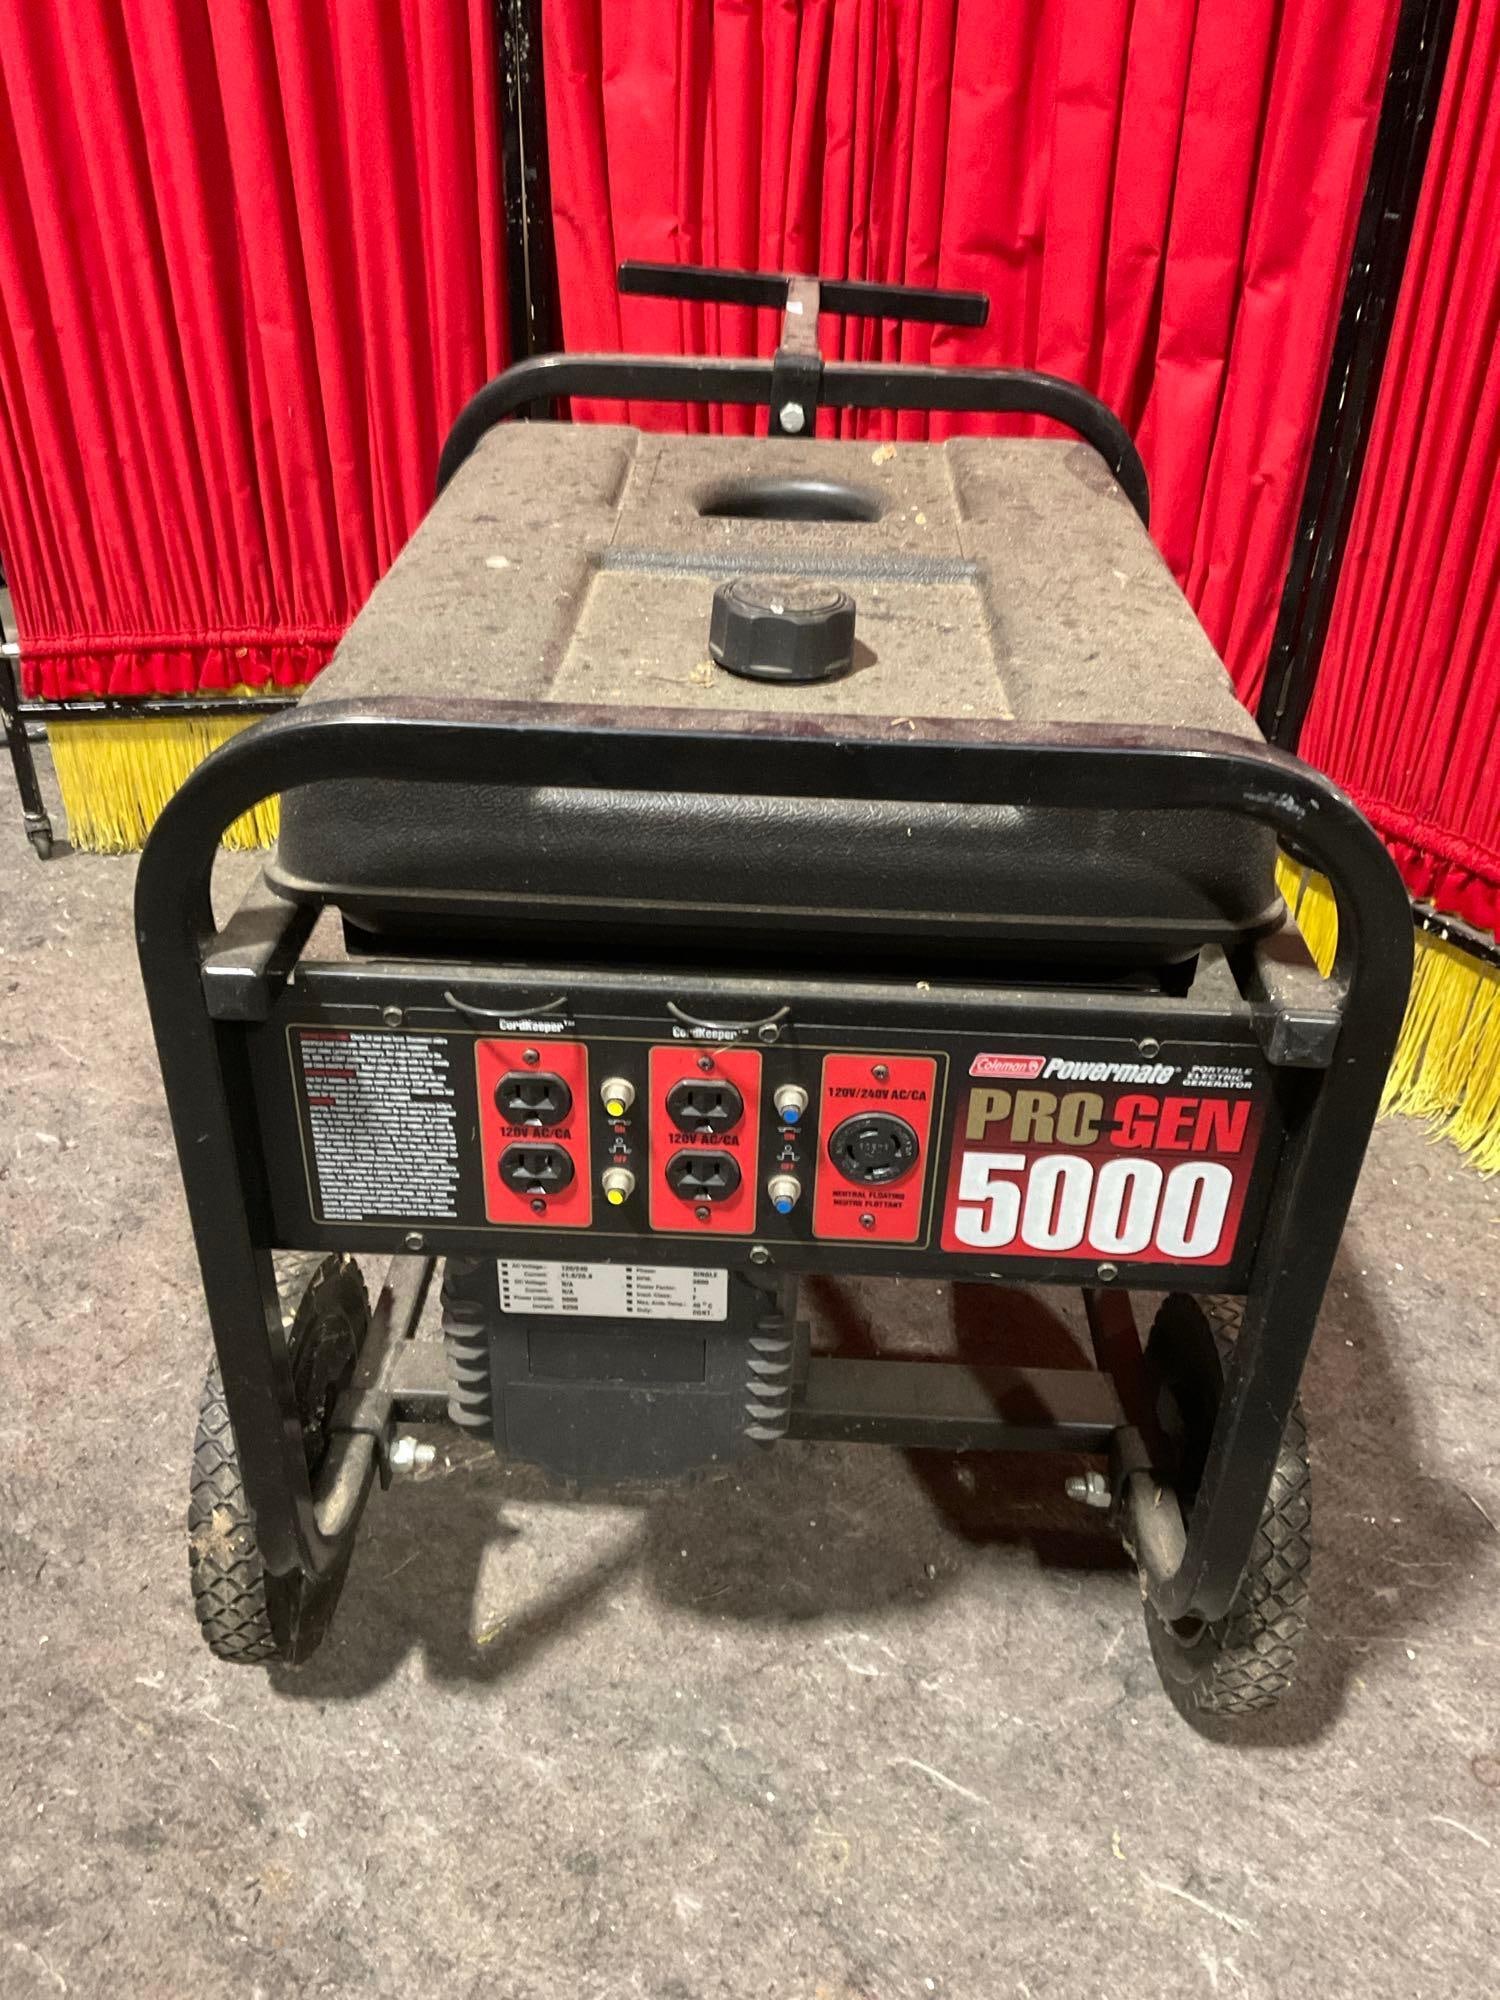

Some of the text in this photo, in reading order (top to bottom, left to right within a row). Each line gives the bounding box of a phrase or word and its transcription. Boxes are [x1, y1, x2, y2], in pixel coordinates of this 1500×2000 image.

[975, 1058, 1029, 1073] Coleman
[1191, 1065, 1253, 1075] PORTABLE
[1187, 1071, 1244, 1082] ELECTRIC
[1182, 1079, 1253, 1089] GENERATOR
[828, 1087, 926, 1100] 120V/240V AC/CA
[500, 1126, 571, 1140] 120V AC/CA
[668, 1133, 740, 1146] 120V AC/CA
[832, 1190, 866, 1198] NEUTRAL
[954, 1151, 1234, 1258] 5000
